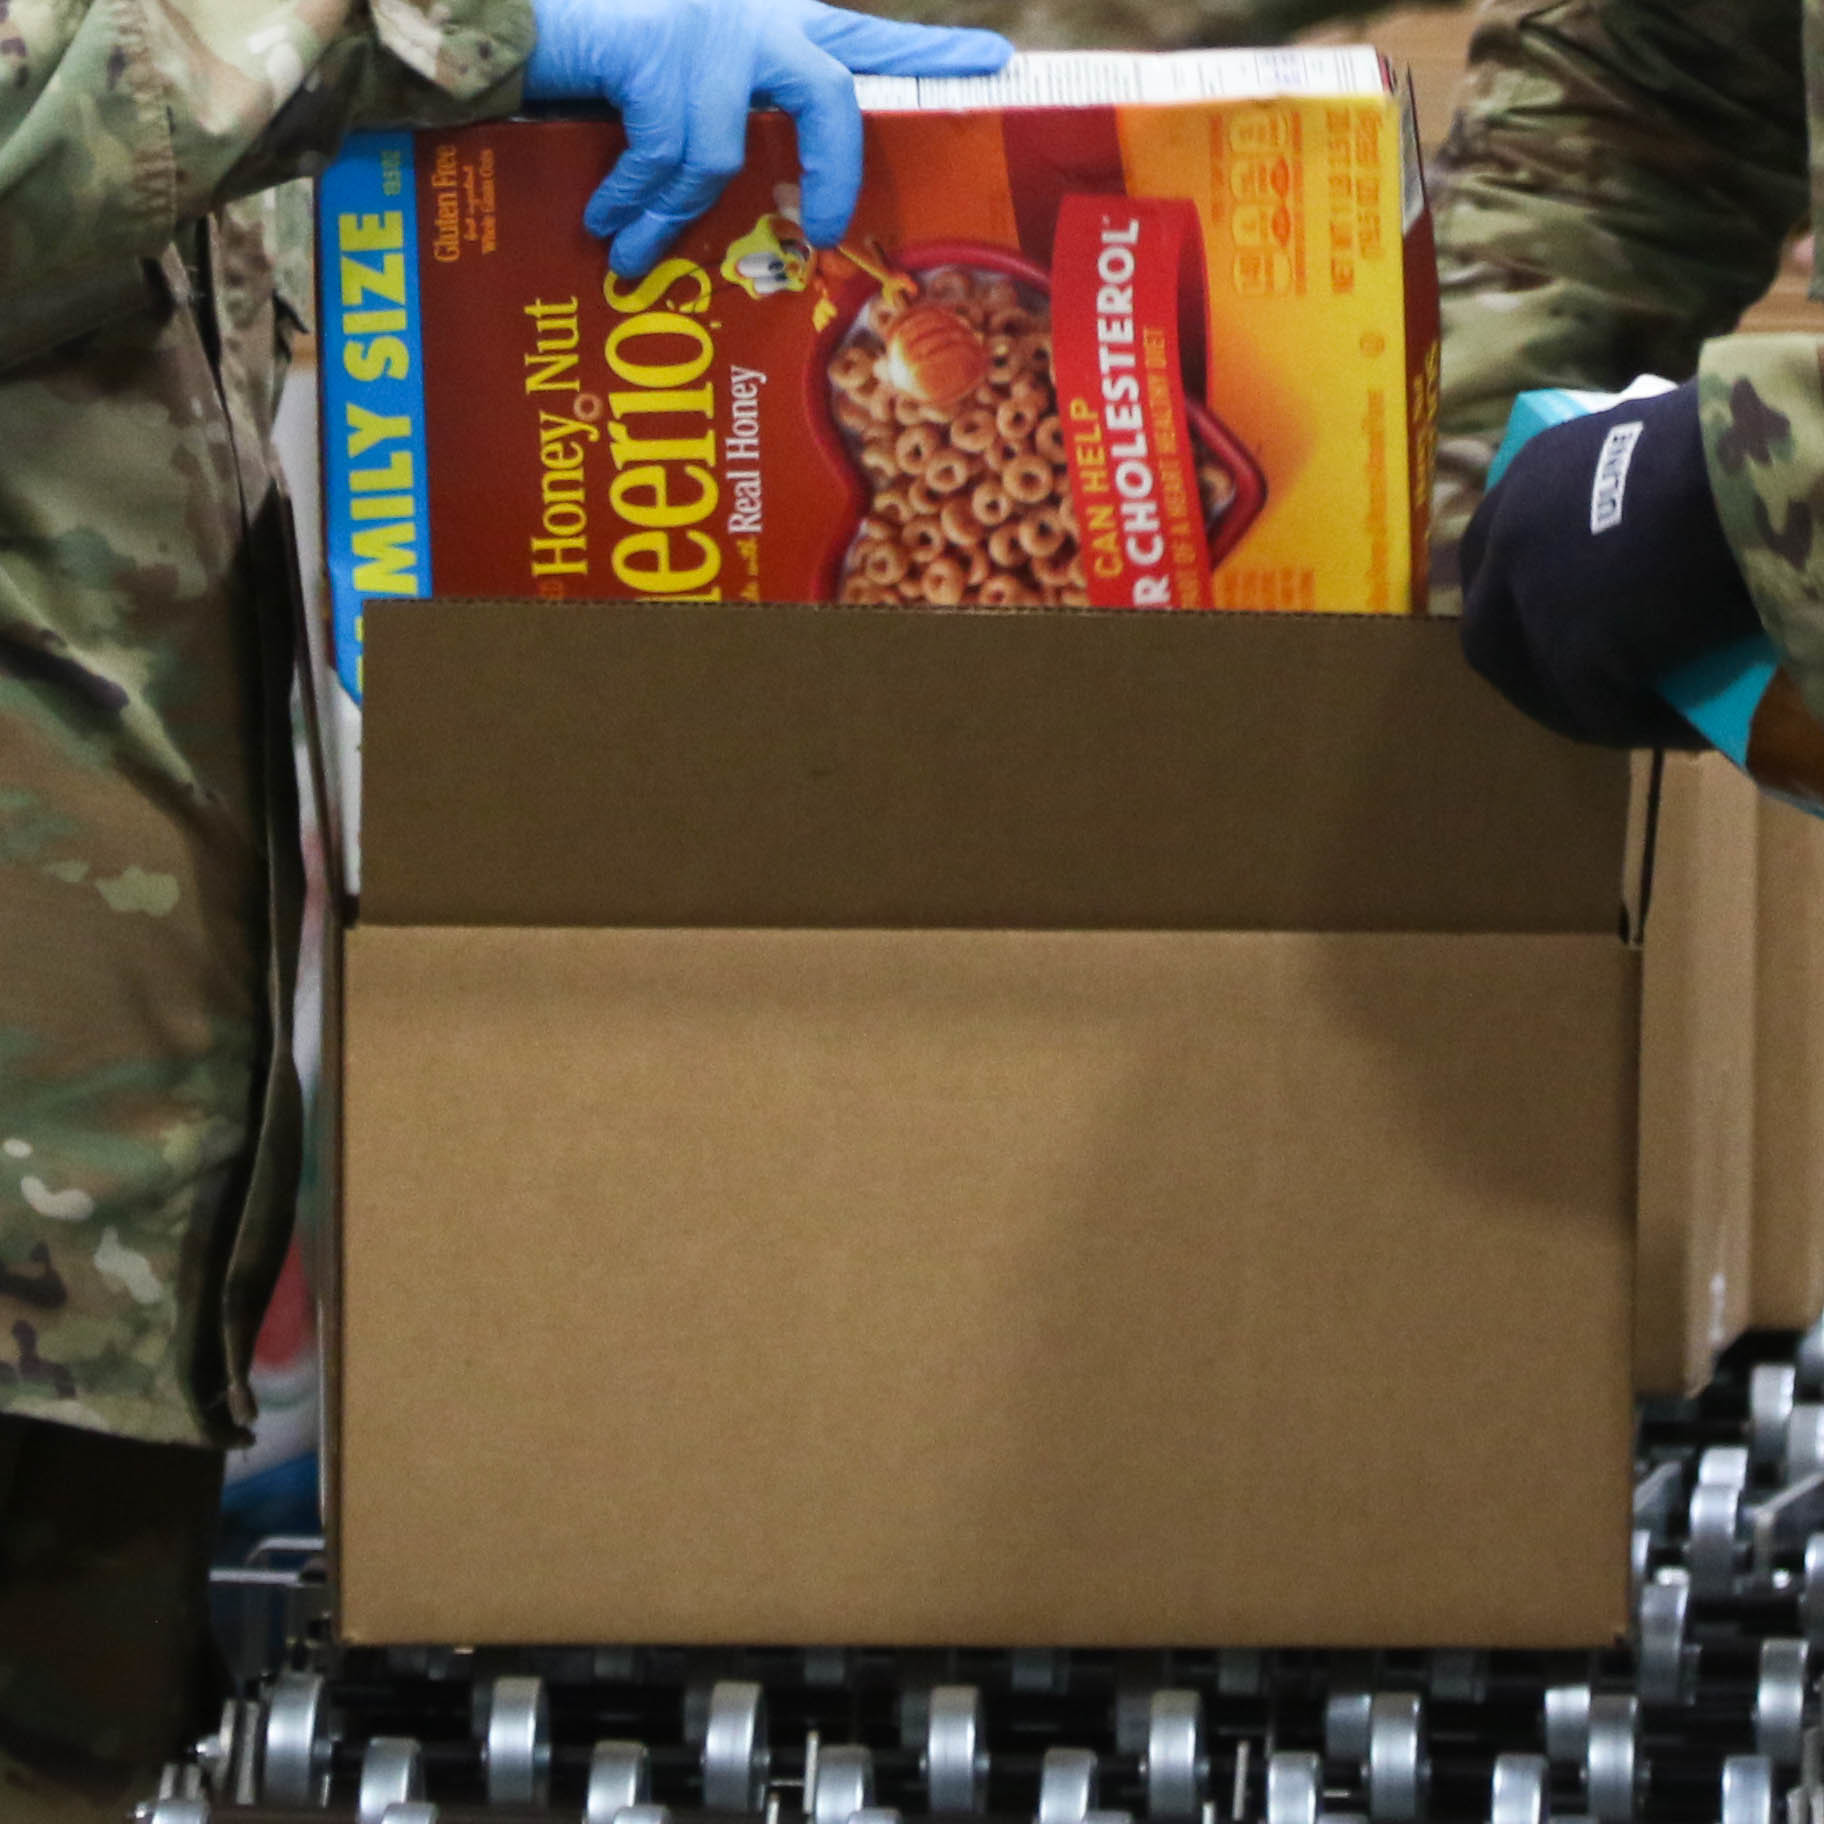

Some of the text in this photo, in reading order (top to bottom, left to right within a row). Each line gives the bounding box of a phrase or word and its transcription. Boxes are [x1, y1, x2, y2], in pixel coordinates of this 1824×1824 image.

[431, 144, 460, 263] Gluten Free
[338, 210, 419, 642] MILY SIZE
[523, 296, 581, 394] Nut
[724, 364, 768, 462] Honey
[1096, 217, 1166, 566] CHOLESTEROL
[530, 409, 600, 577] Honey
[603, 257, 723, 602] eerios
[725, 469, 764, 535] Real
[1069, 396, 1124, 578] CAN HELP
